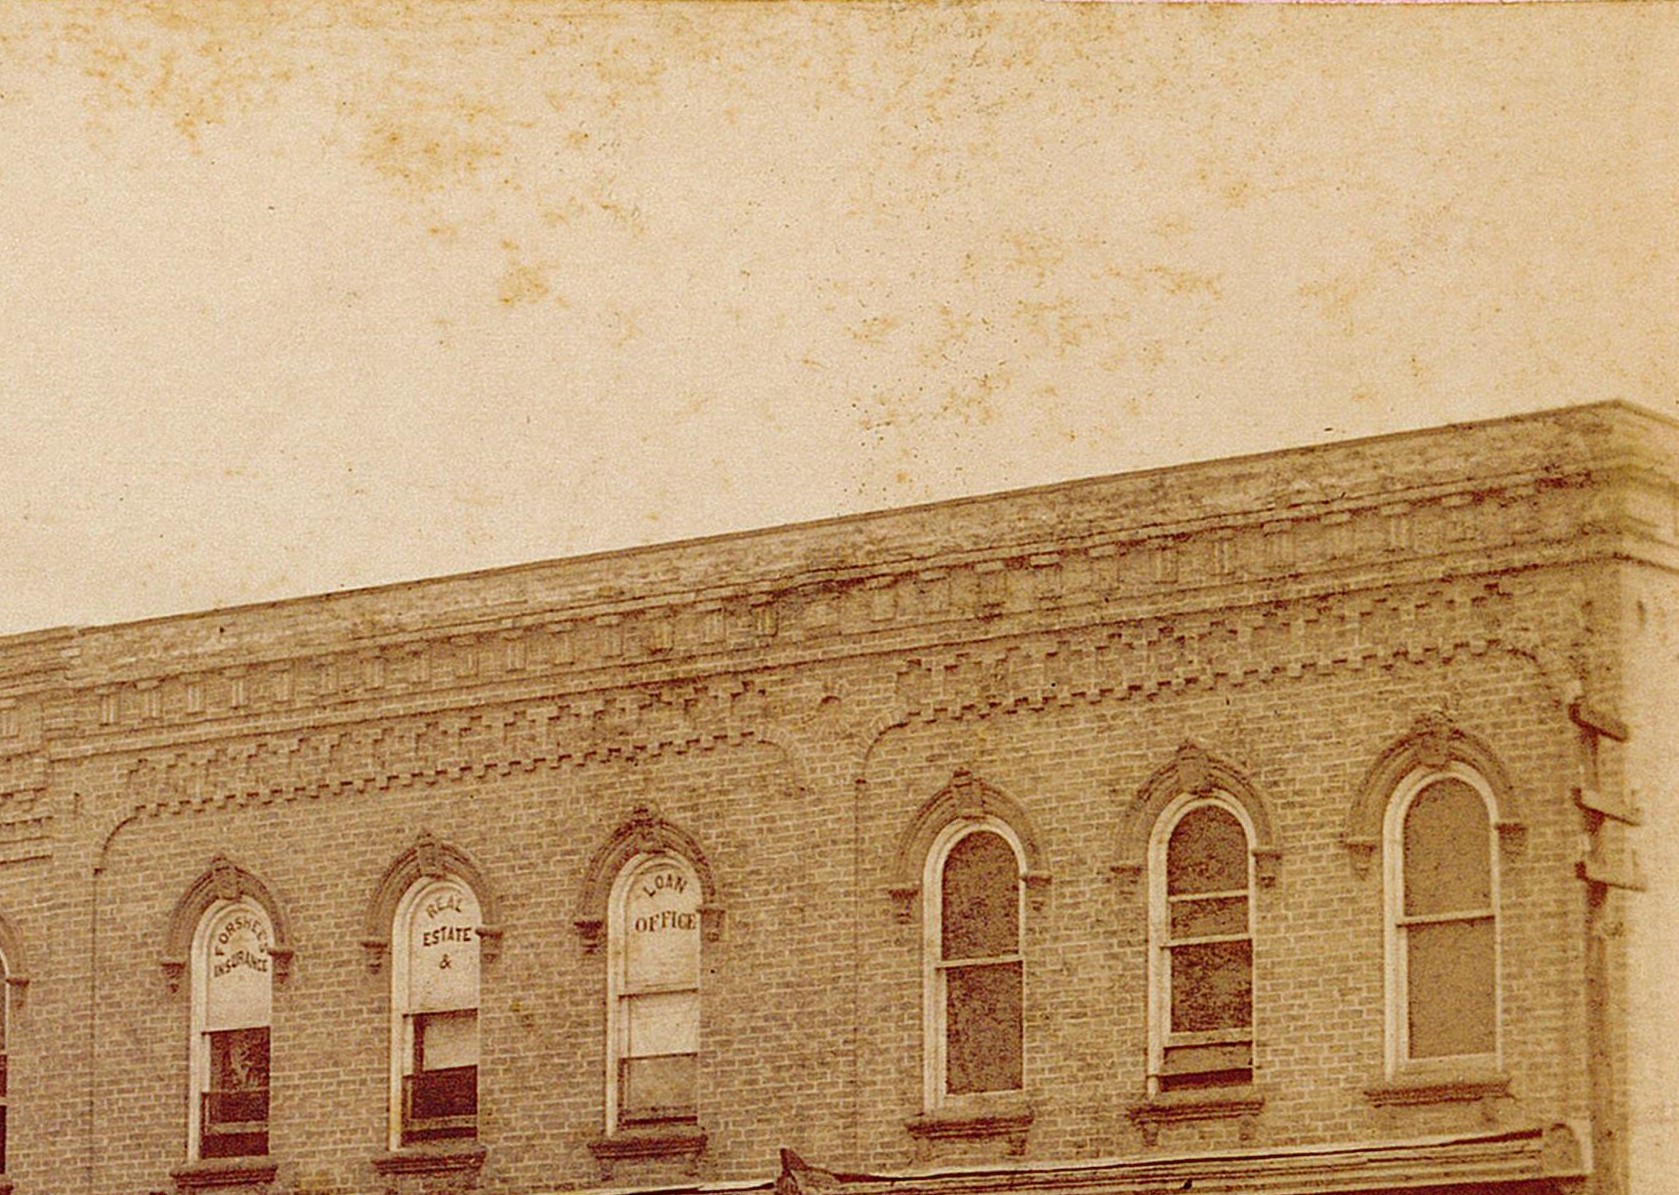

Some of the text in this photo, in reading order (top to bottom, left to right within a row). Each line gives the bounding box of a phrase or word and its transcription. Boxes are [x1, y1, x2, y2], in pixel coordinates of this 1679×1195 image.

[642, 874, 688, 897] LOAN
[426, 894, 462, 919] REAL
[635, 910, 696, 932] OFFICE
[423, 926, 472, 947] ESTATE
[439, 953, 452, 970] &
